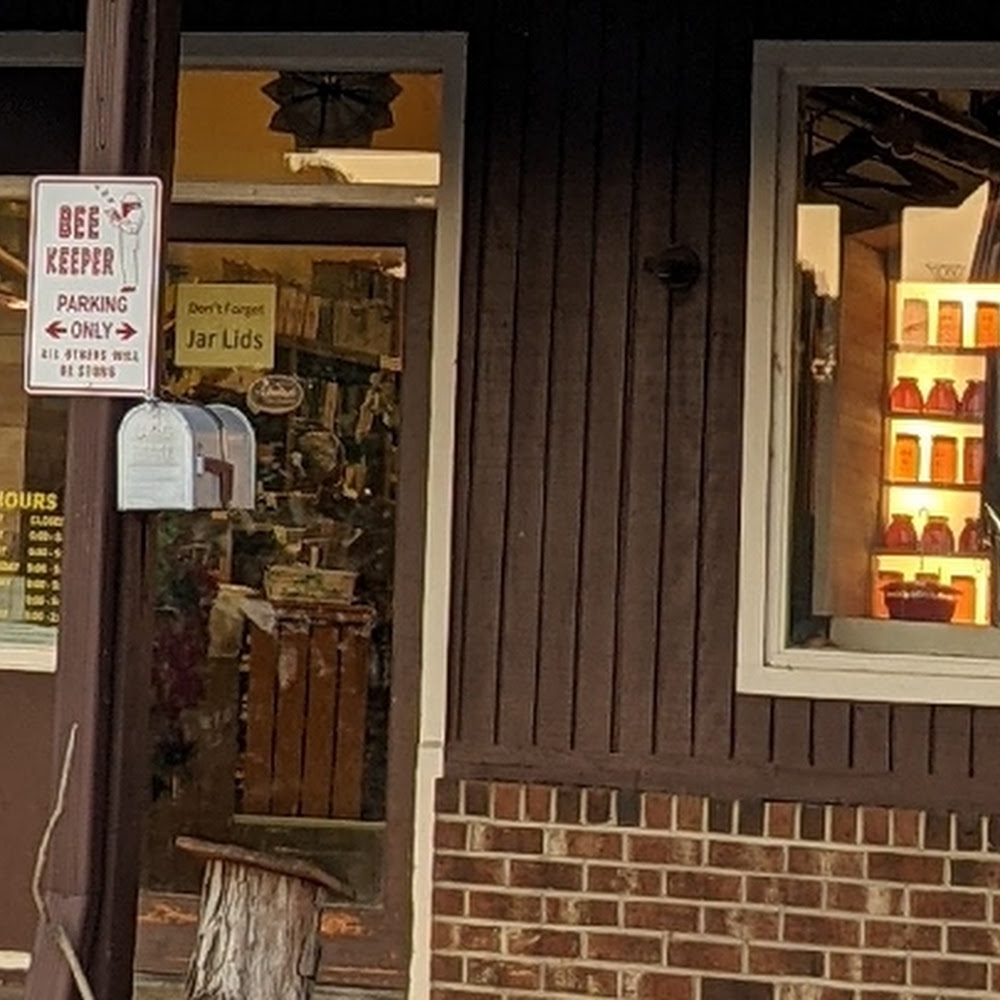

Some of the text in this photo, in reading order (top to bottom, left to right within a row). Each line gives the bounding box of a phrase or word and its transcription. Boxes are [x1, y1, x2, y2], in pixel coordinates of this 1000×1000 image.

[58, 204, 100, 240] BEE
[46, 246, 115, 276] KEEPER
[56, 294, 128, 314] PARKING
[70, 320, 114, 340] ONLY
[186, 328, 263, 350] Jar Lids
